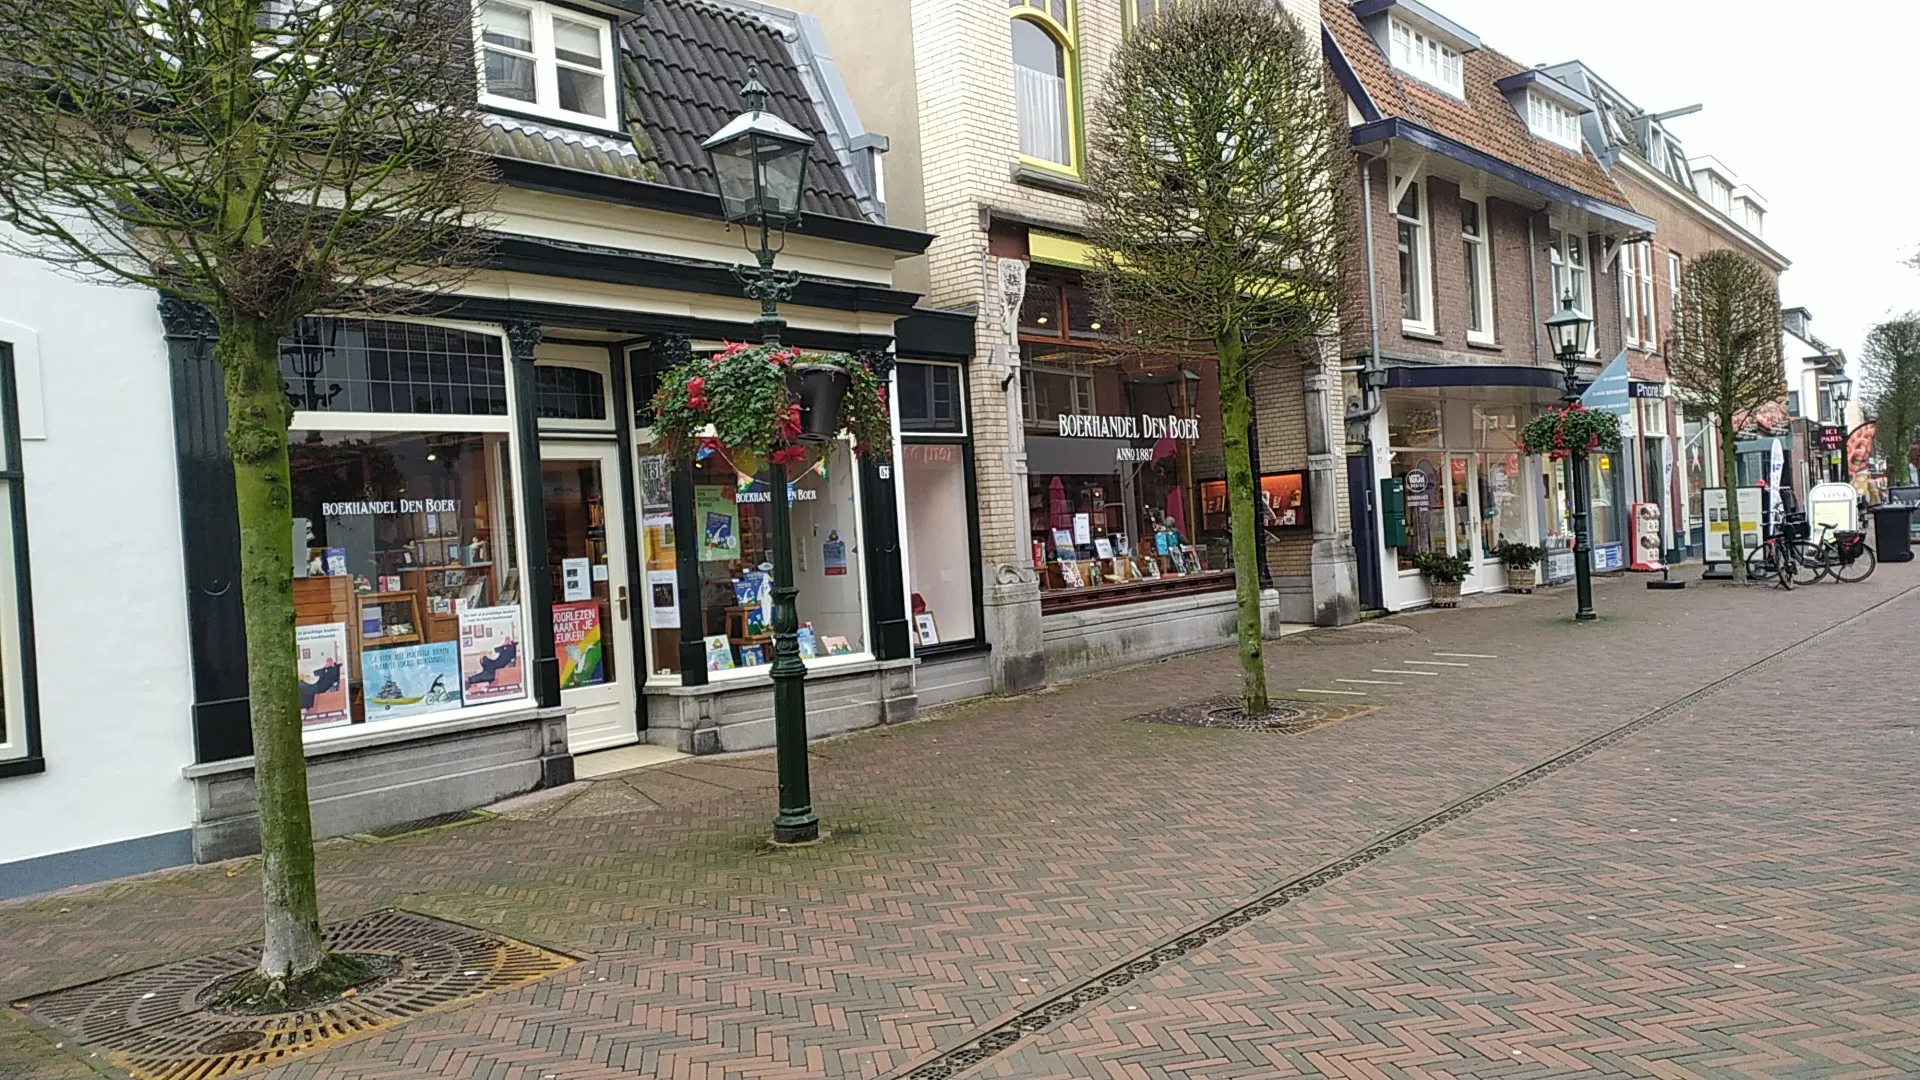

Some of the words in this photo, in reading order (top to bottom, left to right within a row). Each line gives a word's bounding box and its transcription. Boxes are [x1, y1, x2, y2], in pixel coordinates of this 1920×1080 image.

[1636, 383, 1659, 397] Phone
[1059, 414, 1140, 438] BOEKHANDEL
[1142, 414, 1167, 438] DEN
[1169, 415, 1199, 439] BOER
[1820, 435, 1842, 443] PARIS
[1135, 448, 1154, 461] 1887
[787, 491, 797, 500] EN
[798, 489, 817, 500] BOER
[322, 501, 397, 515] BOEKHANDEL
[400, 499, 423, 513] DEN
[425, 498, 456, 512] BOER
[582, 619, 593, 630] JE
